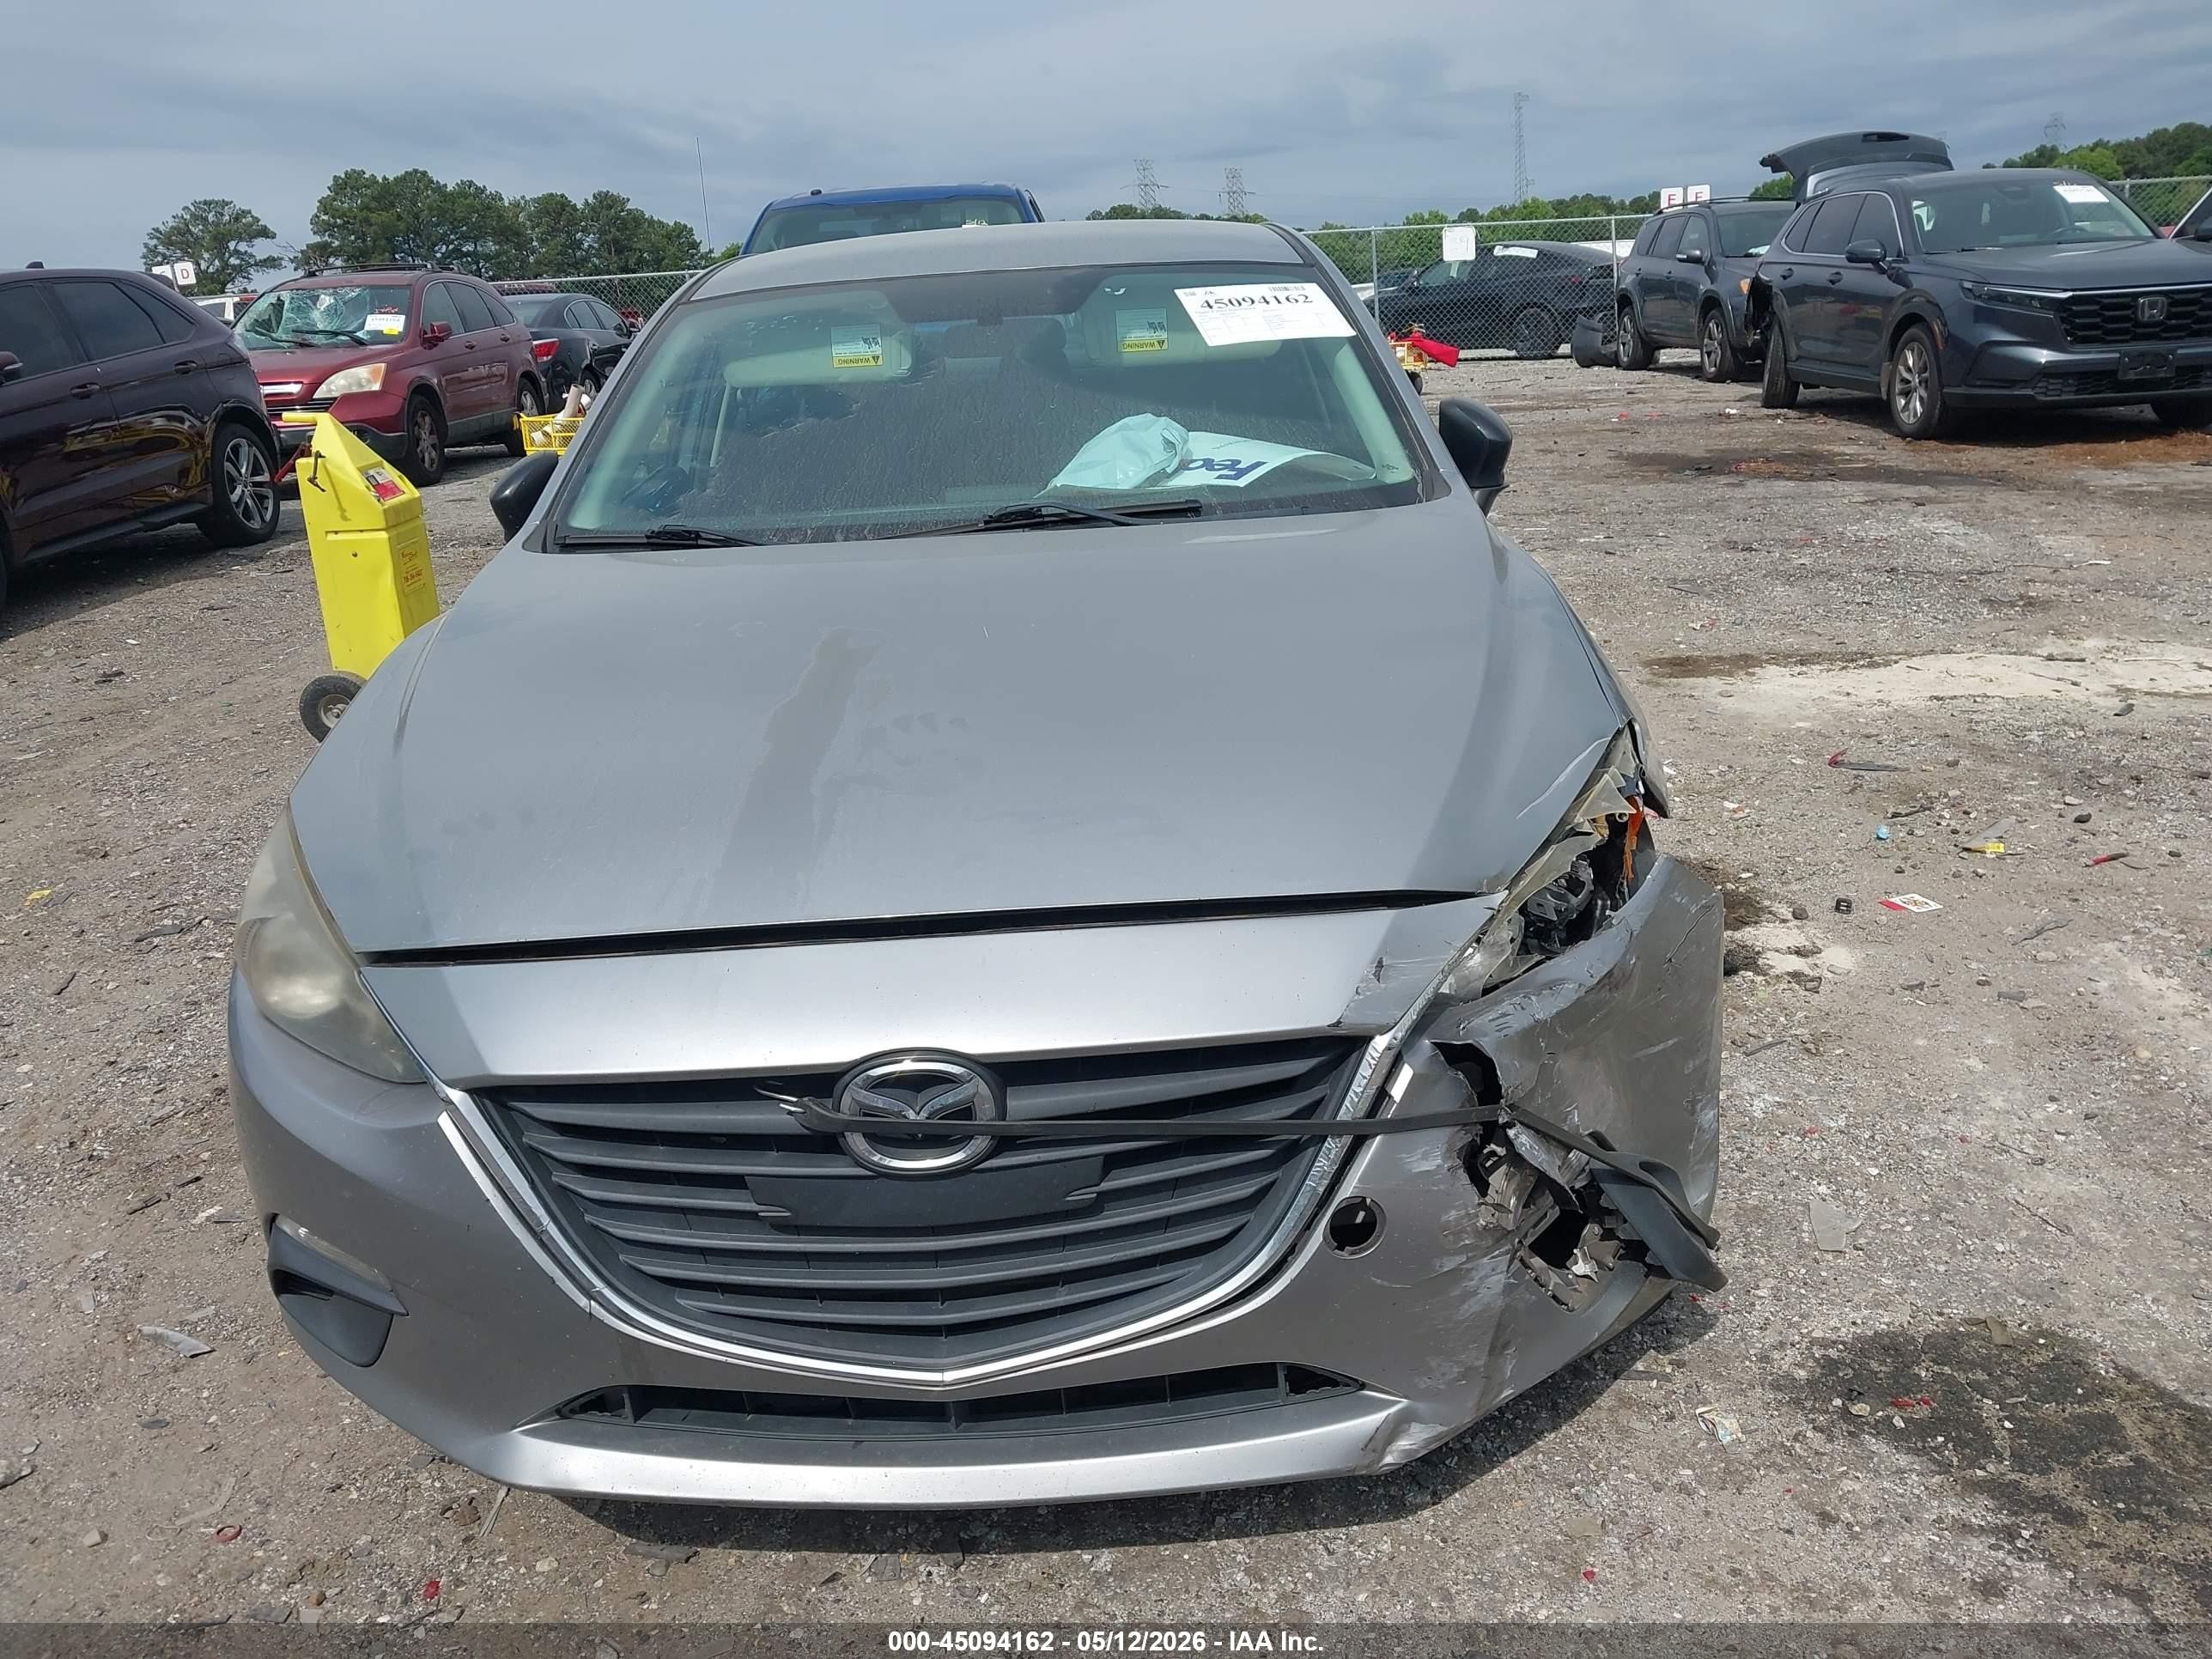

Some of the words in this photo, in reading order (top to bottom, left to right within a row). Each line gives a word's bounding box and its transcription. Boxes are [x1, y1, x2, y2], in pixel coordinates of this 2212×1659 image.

[179, 268, 190, 279] D
[1200, 293, 1313, 310] 45094162
[1121, 341, 1156, 349] WARNING
[837, 356, 871, 365] WARNING
